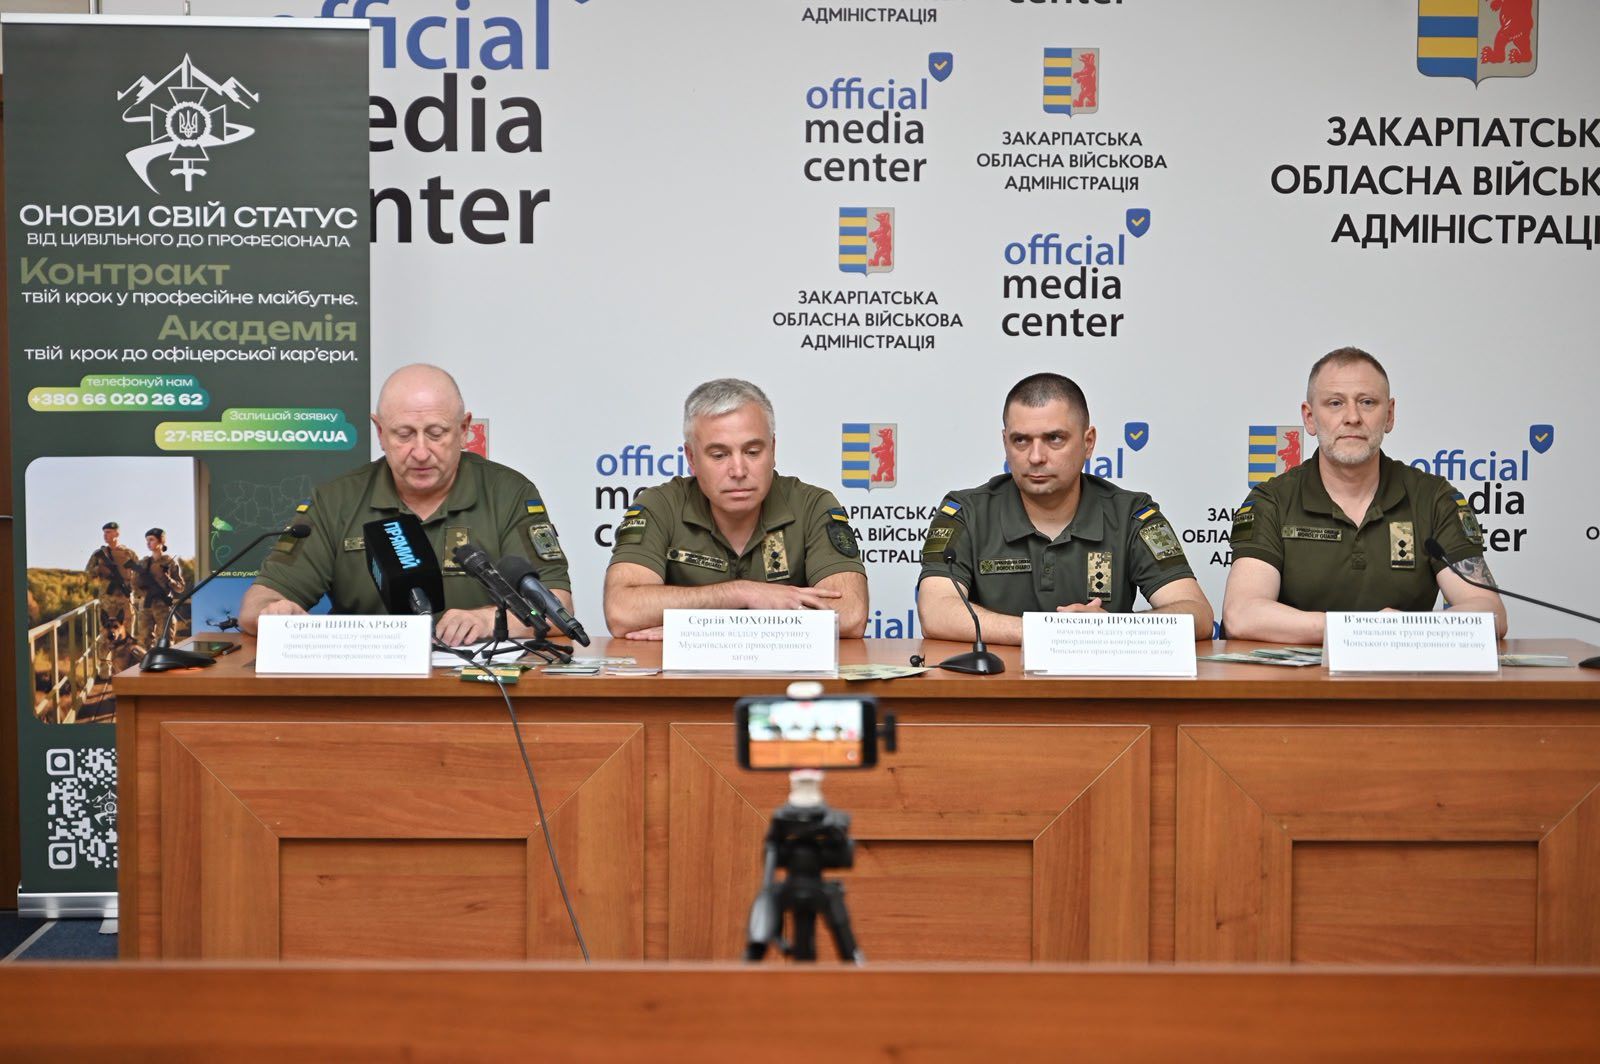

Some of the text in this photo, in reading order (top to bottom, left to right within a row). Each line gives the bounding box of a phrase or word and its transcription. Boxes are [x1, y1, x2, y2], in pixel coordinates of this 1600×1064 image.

[802, 8, 937, 24] АДМІНІСТРАЦІЯ
[272, 0, 550, 70] icial
[805, 77, 928, 110] official
[369, 73, 543, 153] edia
[804, 111, 925, 144] media
[1326, 116, 1600, 148] ЗАКАРПАТСЬК
[1002, 131, 1143, 147] ЗАКАРПАТСЬКА
[803, 154, 927, 182] center
[976, 151, 1168, 169] ОБЛАСНА ВІЙСЬКОВА
[1004, 176, 1140, 193] АДМІНІСТРАЦІЯ
[1271, 160, 1600, 196] ОБЛАСНА ВІЙСЬК
[19, 201, 358, 229] ОНОВИ СВІЙ СТАТУС
[369, 176, 550, 244] nter
[27, 233, 350, 248] ВІД ЦИВІЛЬНОГО ДО ПРОФЕСІОНАЛА
[1331, 214, 1600, 250] АДМІНІСТРАЦІ
[1004, 233, 1126, 266] official
[20, 257, 230, 290] Контракт
[1002, 266, 1122, 299] media
[22, 289, 358, 307] твій крок у професійне майбутнє.
[798, 290, 939, 306] ЗАКАРПАТСЬКА
[772, 311, 963, 329] ОБЛАСНА ВІЙСЬКОВА
[1001, 309, 1124, 337] center
[158, 314, 356, 345] Академія
[800, 334, 936, 352] АДМІНІСТРАЦІЯ
[24, 346, 358, 364] твій крок до офіцерської кар'єри.
[87, 375, 193, 389] телефонуй нам
[32, 393, 203, 406] +380 66 020 26 62
[230, 409, 338, 424] Залишай заявку
[164, 429, 348, 444] 27-REC.DPSU.GOV.UA
[596, 444, 692, 476] offici
[1468, 482, 1524, 515] dia
[842, 506, 939, 520] РПАТСЬКА
[868, 525, 927, 541] ВІЙСЬК
[1182, 529, 1230, 543] ОБЛА
[383, 521, 421, 569] ПРЯМИЙ
[232, 570, 260, 578] служб
[284, 620, 408, 631] Сергій ШИНКАРЬОВ
[688, 615, 803, 626] Сергій МОХОНЬОК
[1044, 615, 1178, 627] Олександр ПРОКОПОВ
[1344, 614, 1482, 625] В'ячеслав ШИНКАРЬОВ
[1399, 629, 1424, 638] групи
[1427, 630, 1475, 639] рекрутингу
[1343, 639, 1388, 647] Чопського
[1391, 640, 1455, 649] прикордонного
